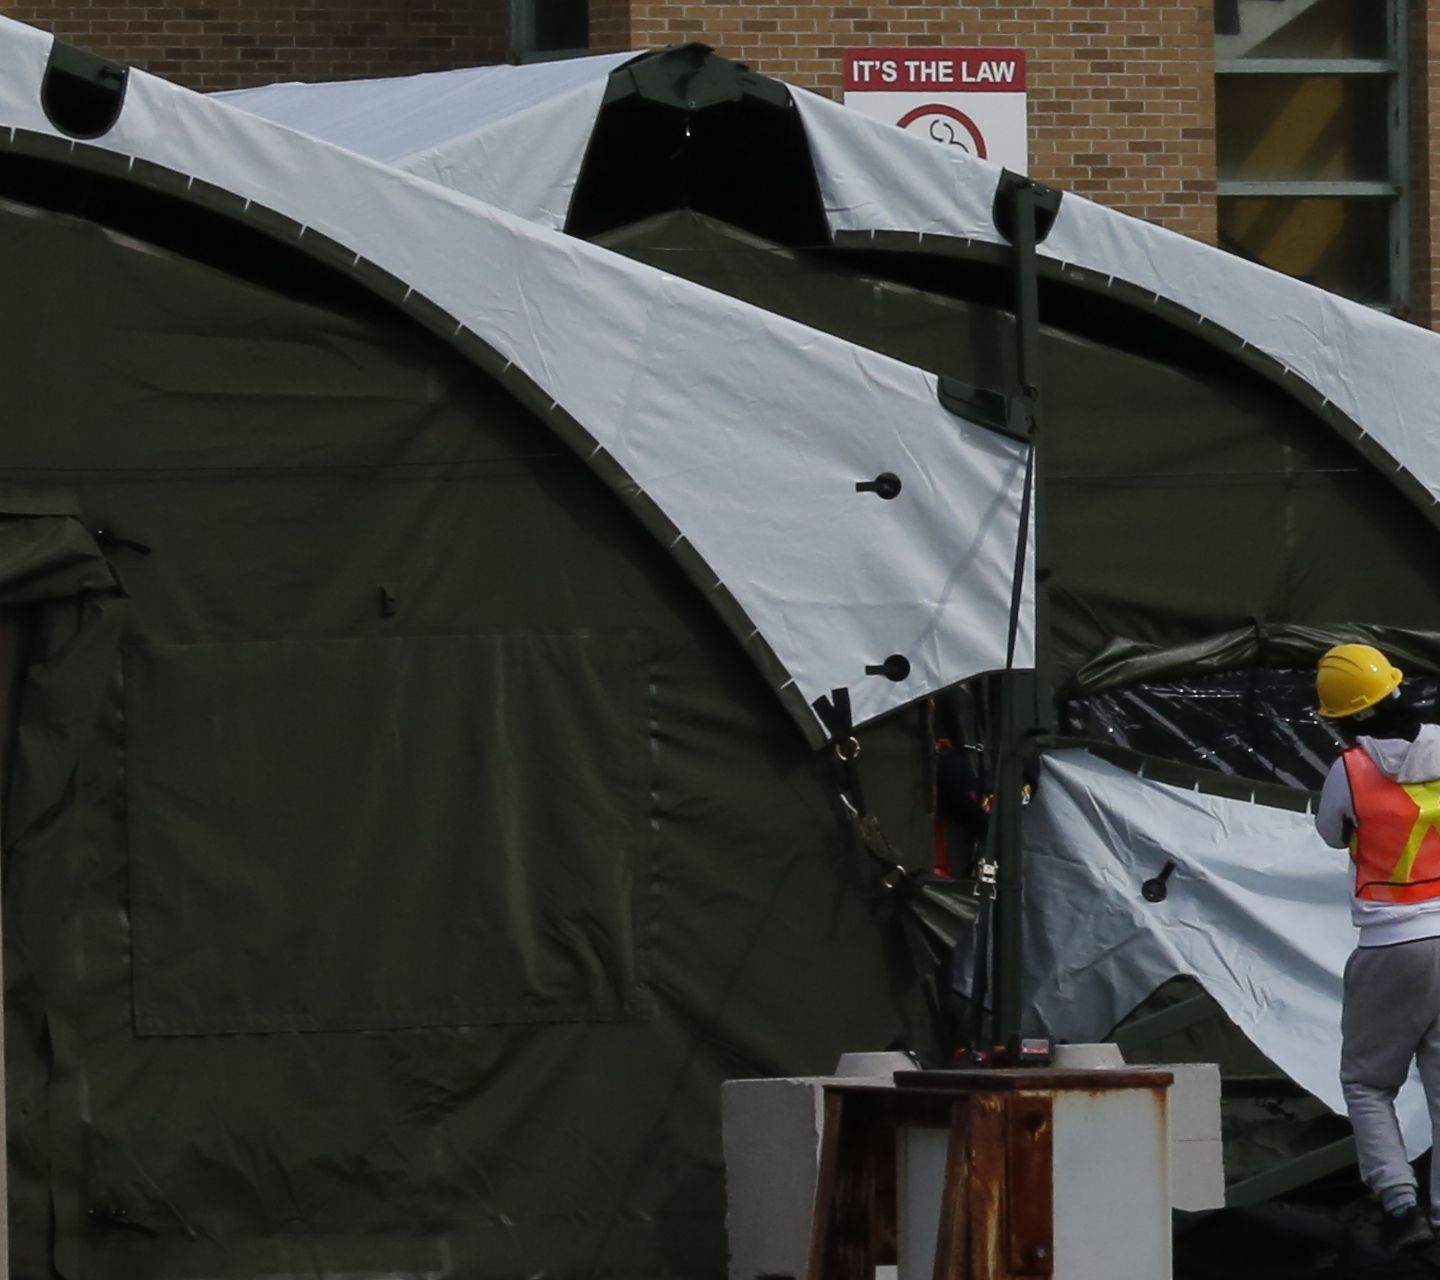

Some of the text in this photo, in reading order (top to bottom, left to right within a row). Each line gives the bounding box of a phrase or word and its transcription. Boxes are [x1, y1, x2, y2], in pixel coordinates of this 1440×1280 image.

[852, 60, 1016, 83] IT'S THE LAW
